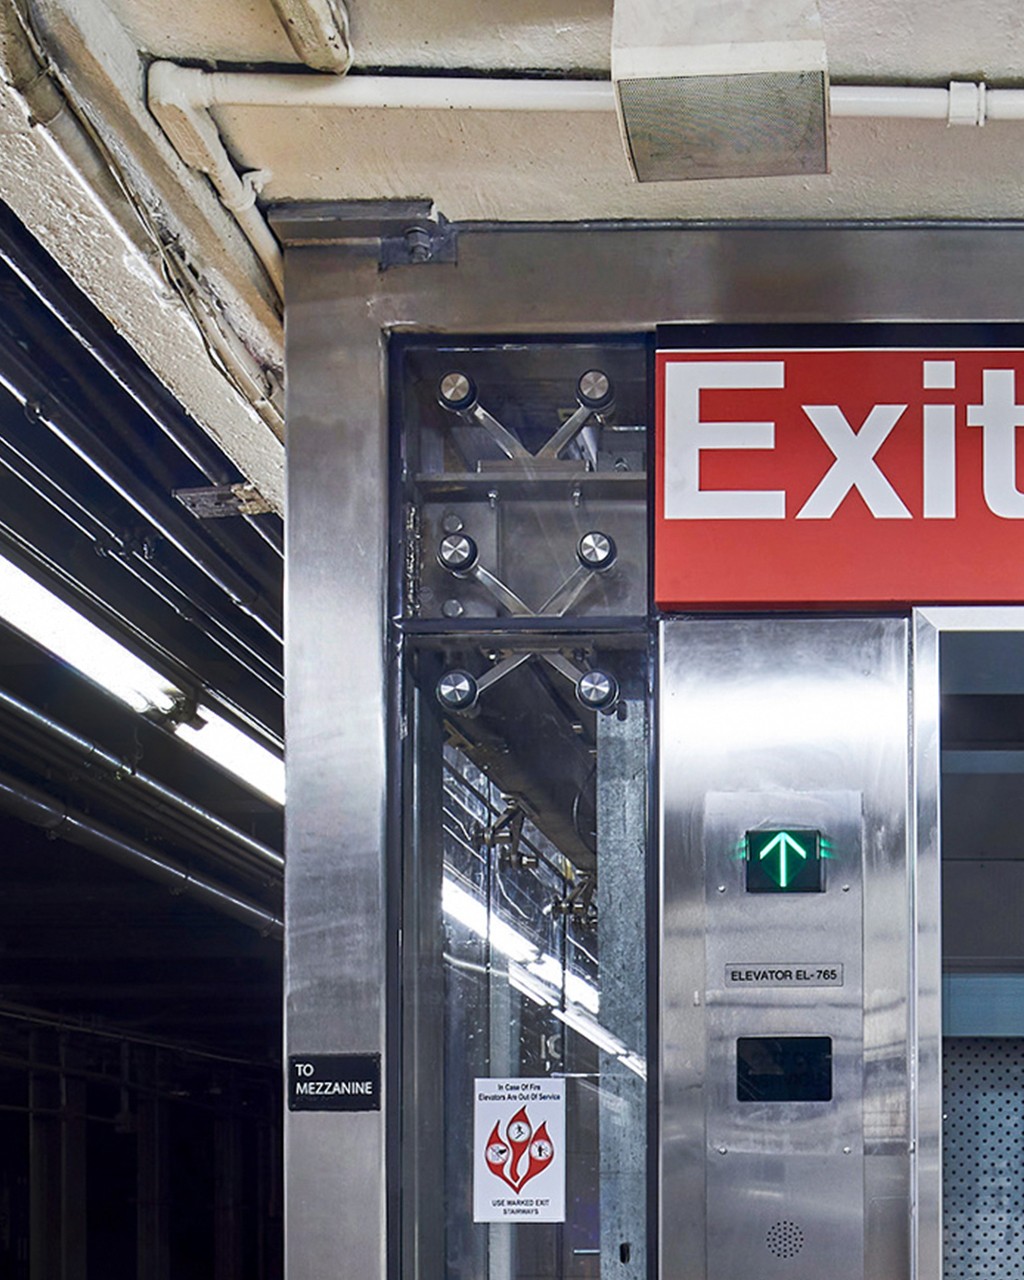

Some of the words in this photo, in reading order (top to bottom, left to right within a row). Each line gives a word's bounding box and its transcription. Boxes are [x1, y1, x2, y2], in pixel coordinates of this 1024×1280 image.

[731, 969, 793, 981] ELEVATOR
[295, 1063, 314, 1077] TO
[295, 1081, 373, 1096] MEZZANINE
